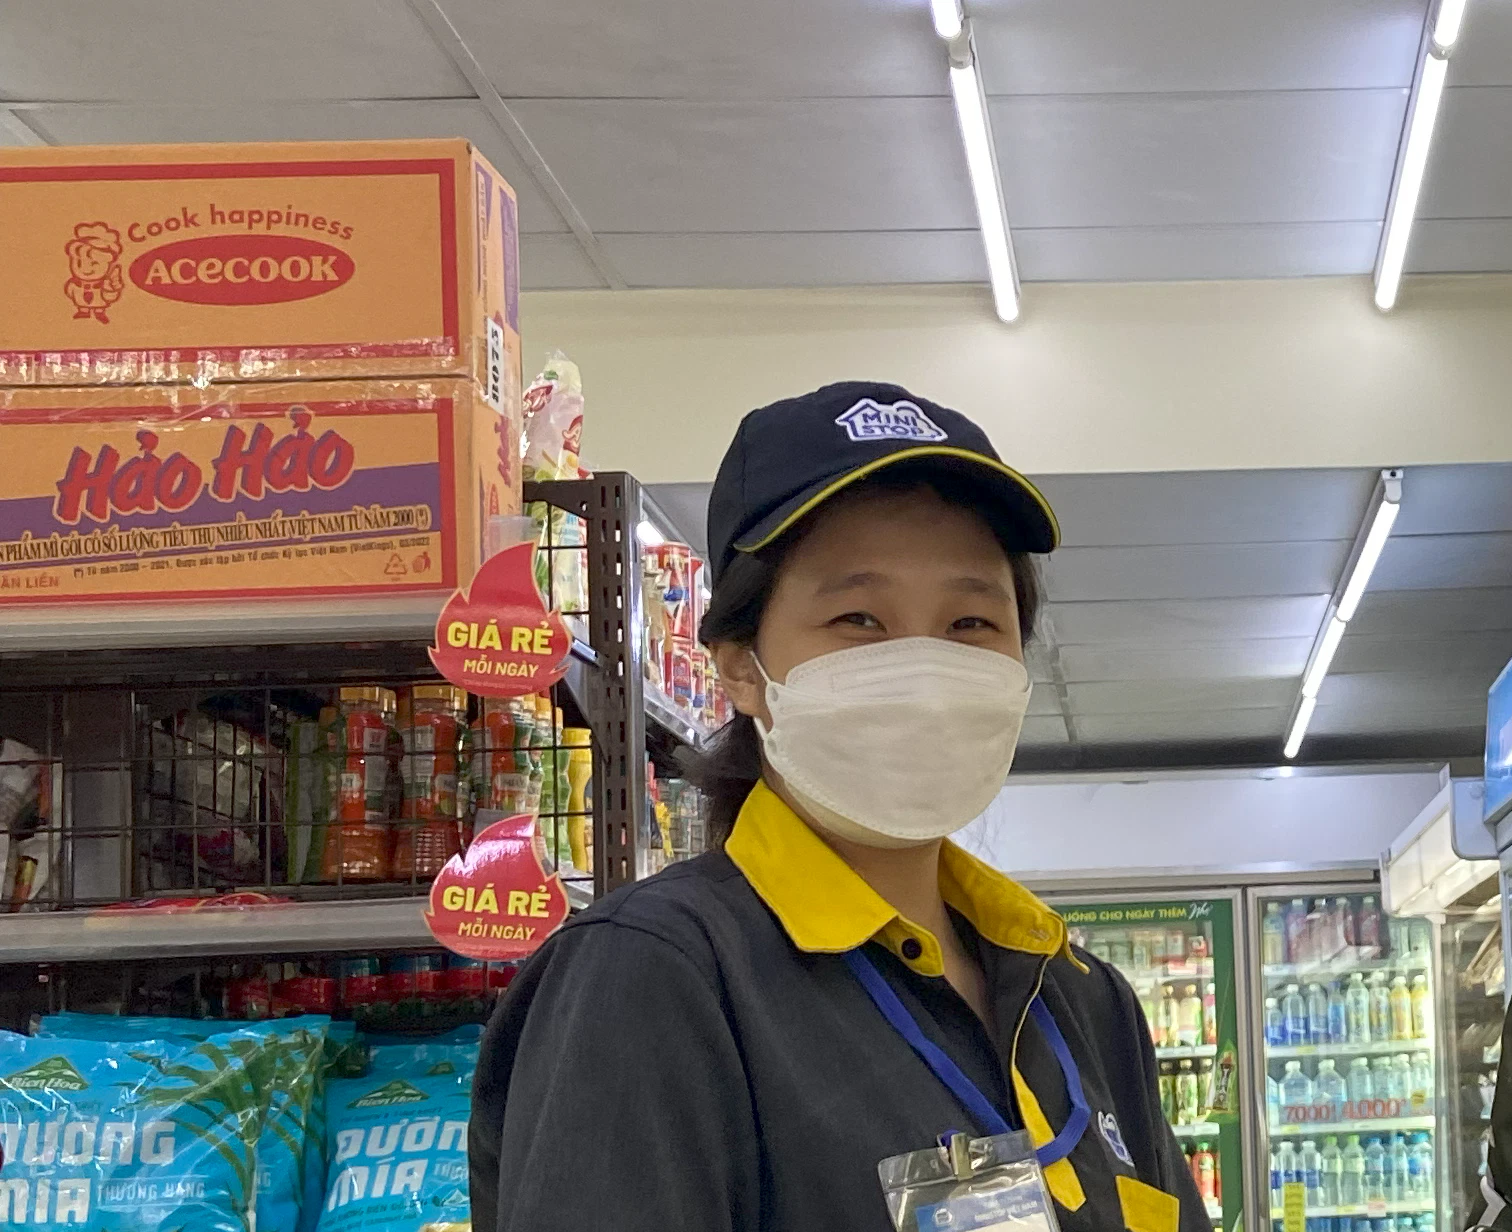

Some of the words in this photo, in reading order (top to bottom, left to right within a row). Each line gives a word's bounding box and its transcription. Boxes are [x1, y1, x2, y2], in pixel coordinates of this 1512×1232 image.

[128, 206, 201, 243] Cook
[210, 203, 354, 240] happiness
[862, 412, 918, 427] MINI
[862, 425, 924, 437] STOP
[55, 430, 202, 523] Hảo
[210, 406, 354, 500] Hảo
[321, 514, 346, 535] NAM
[447, 618, 502, 651] GIÁ
[510, 620, 555, 656] RẺ
[463, 653, 492, 675] MỖI
[494, 659, 539, 678] NGÀY
[442, 883, 499, 914] GIÁ
[507, 884, 551, 918] RẺ
[457, 917, 489, 938] MỖI
[490, 923, 536, 941] NGÀY
